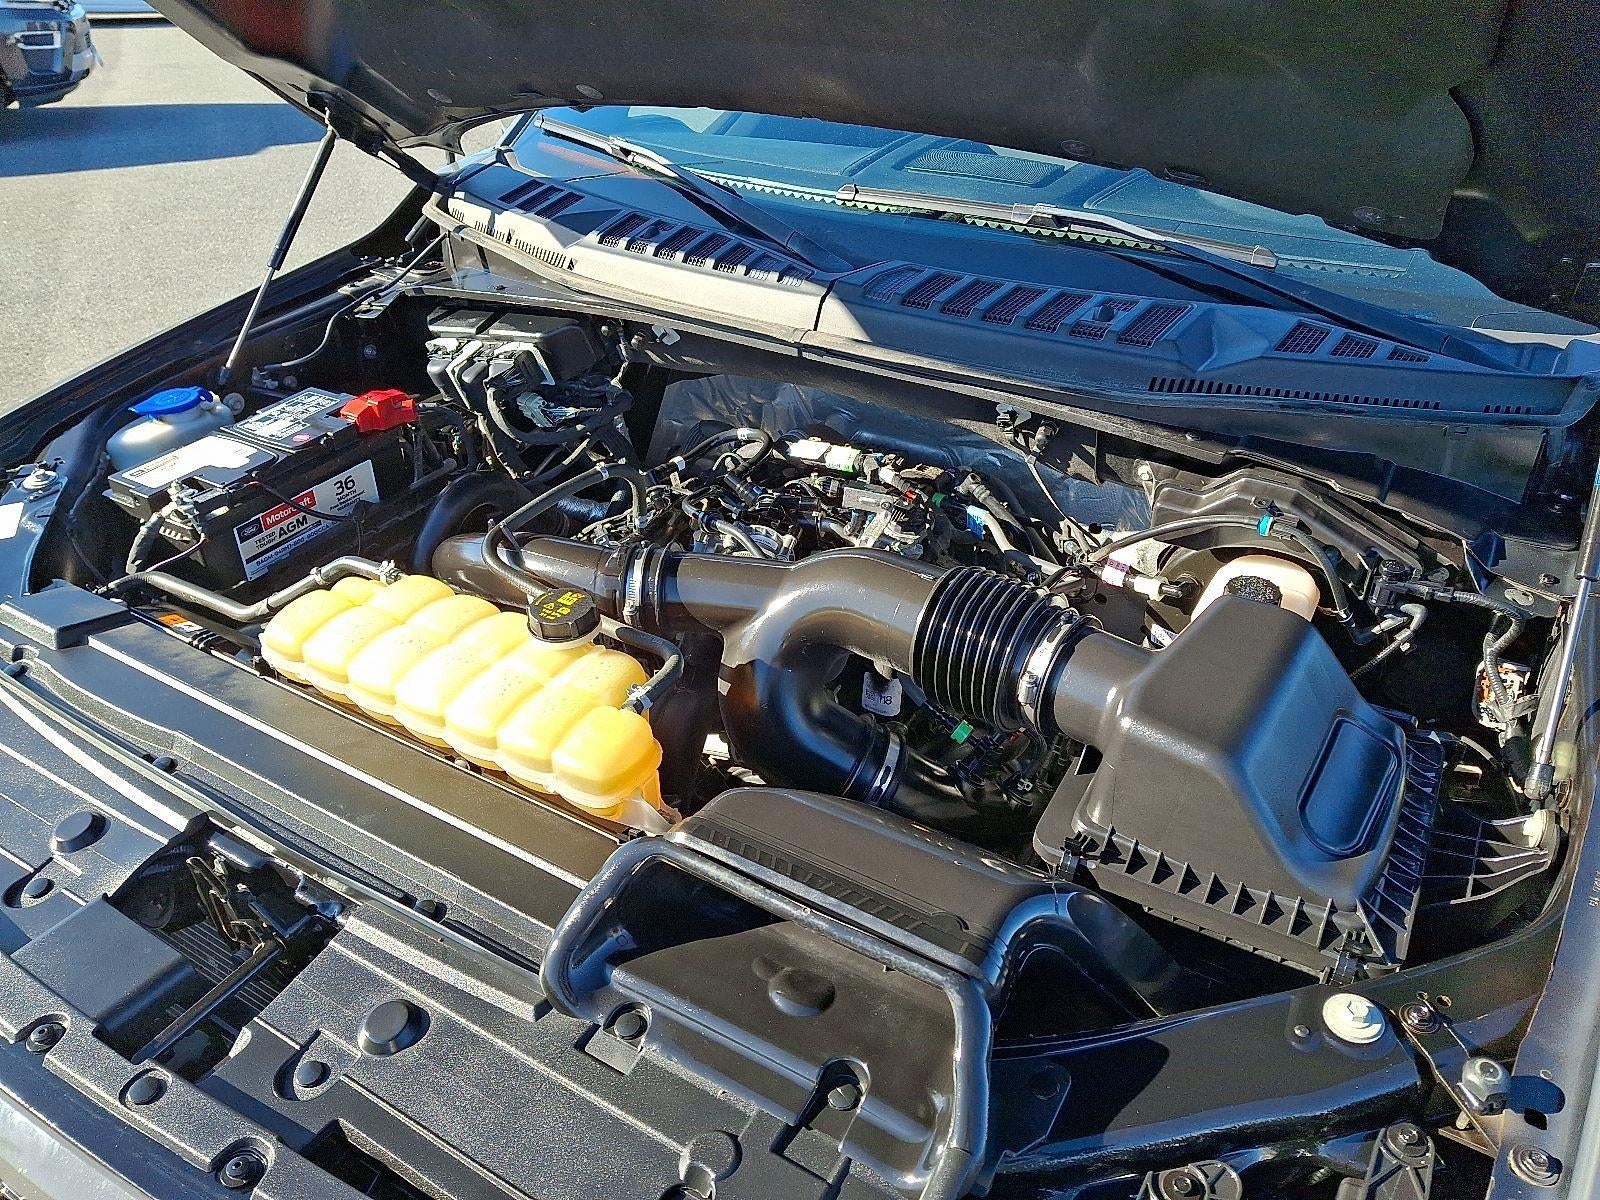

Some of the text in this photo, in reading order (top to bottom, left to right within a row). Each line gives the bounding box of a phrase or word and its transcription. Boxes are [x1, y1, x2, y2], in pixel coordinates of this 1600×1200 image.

[333, 475, 356, 496] 36
[337, 489, 357, 502] MONTH
[266, 496, 312, 525] Motorcaft
[278, 514, 309, 538] AGM
[254, 531, 276, 545] TESTED
